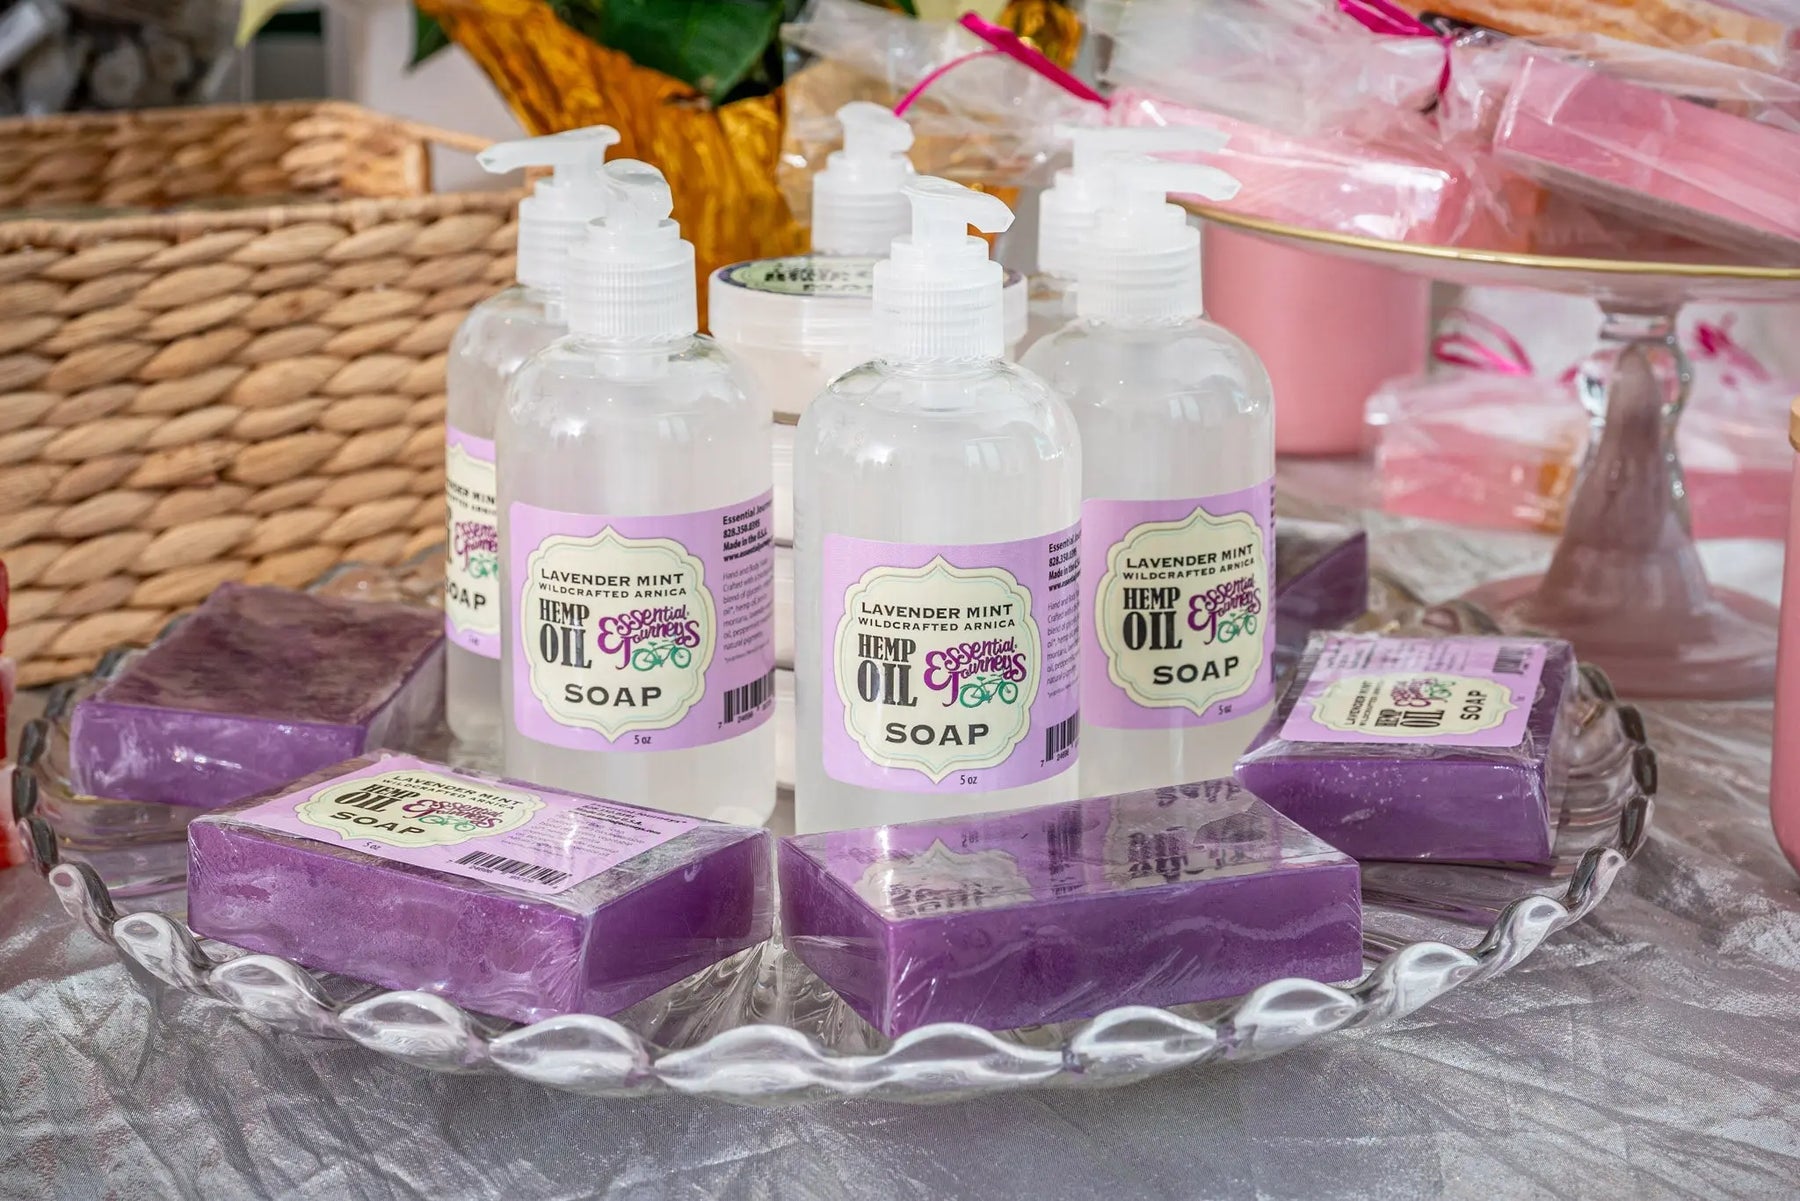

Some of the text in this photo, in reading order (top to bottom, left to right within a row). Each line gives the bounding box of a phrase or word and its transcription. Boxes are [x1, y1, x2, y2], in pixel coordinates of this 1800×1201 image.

[723, 506, 755, 525] Essential
[723, 539, 741, 551] Made
[1126, 544, 1254, 569] LAVENDER MINT
[541, 569, 684, 587] LAVENDER MINT
[1123, 558, 1254, 580] WILDCRAFTED ARNICA
[539, 582, 687, 598] WILDCRAFTED ARNICA
[1123, 587, 1181, 610] HEMP
[539, 598, 590, 626] HEMP
[861, 602, 1013, 619] LAVENDER MINT
[858, 617, 1015, 631] WILDCRAFTED ARNICA
[1123, 611, 1183, 650] OIL
[540, 624, 592, 668] OIL
[857, 633, 916, 662] HEMP
[924, 636, 1017, 690] Essential
[1153, 656, 1239, 685] SOAP
[857, 660, 917, 707] OIL
[942, 652, 1027, 707] Journeys
[565, 684, 662, 707] SOAP
[1460, 690, 1487, 721] SOAP
[1400, 710, 1445, 728] OIL
[634, 735, 640, 744] 5
[885, 722, 989, 746] SOAP
[360, 784, 421, 799] HEMP
[393, 775, 524, 806] LAVENDER MINT
[960, 775, 977, 785] 5 oz
[334, 791, 402, 812] OIL
[382, 779, 515, 810] WILDCRAFTED ARNICA
[330, 811, 425, 834] SOAP
